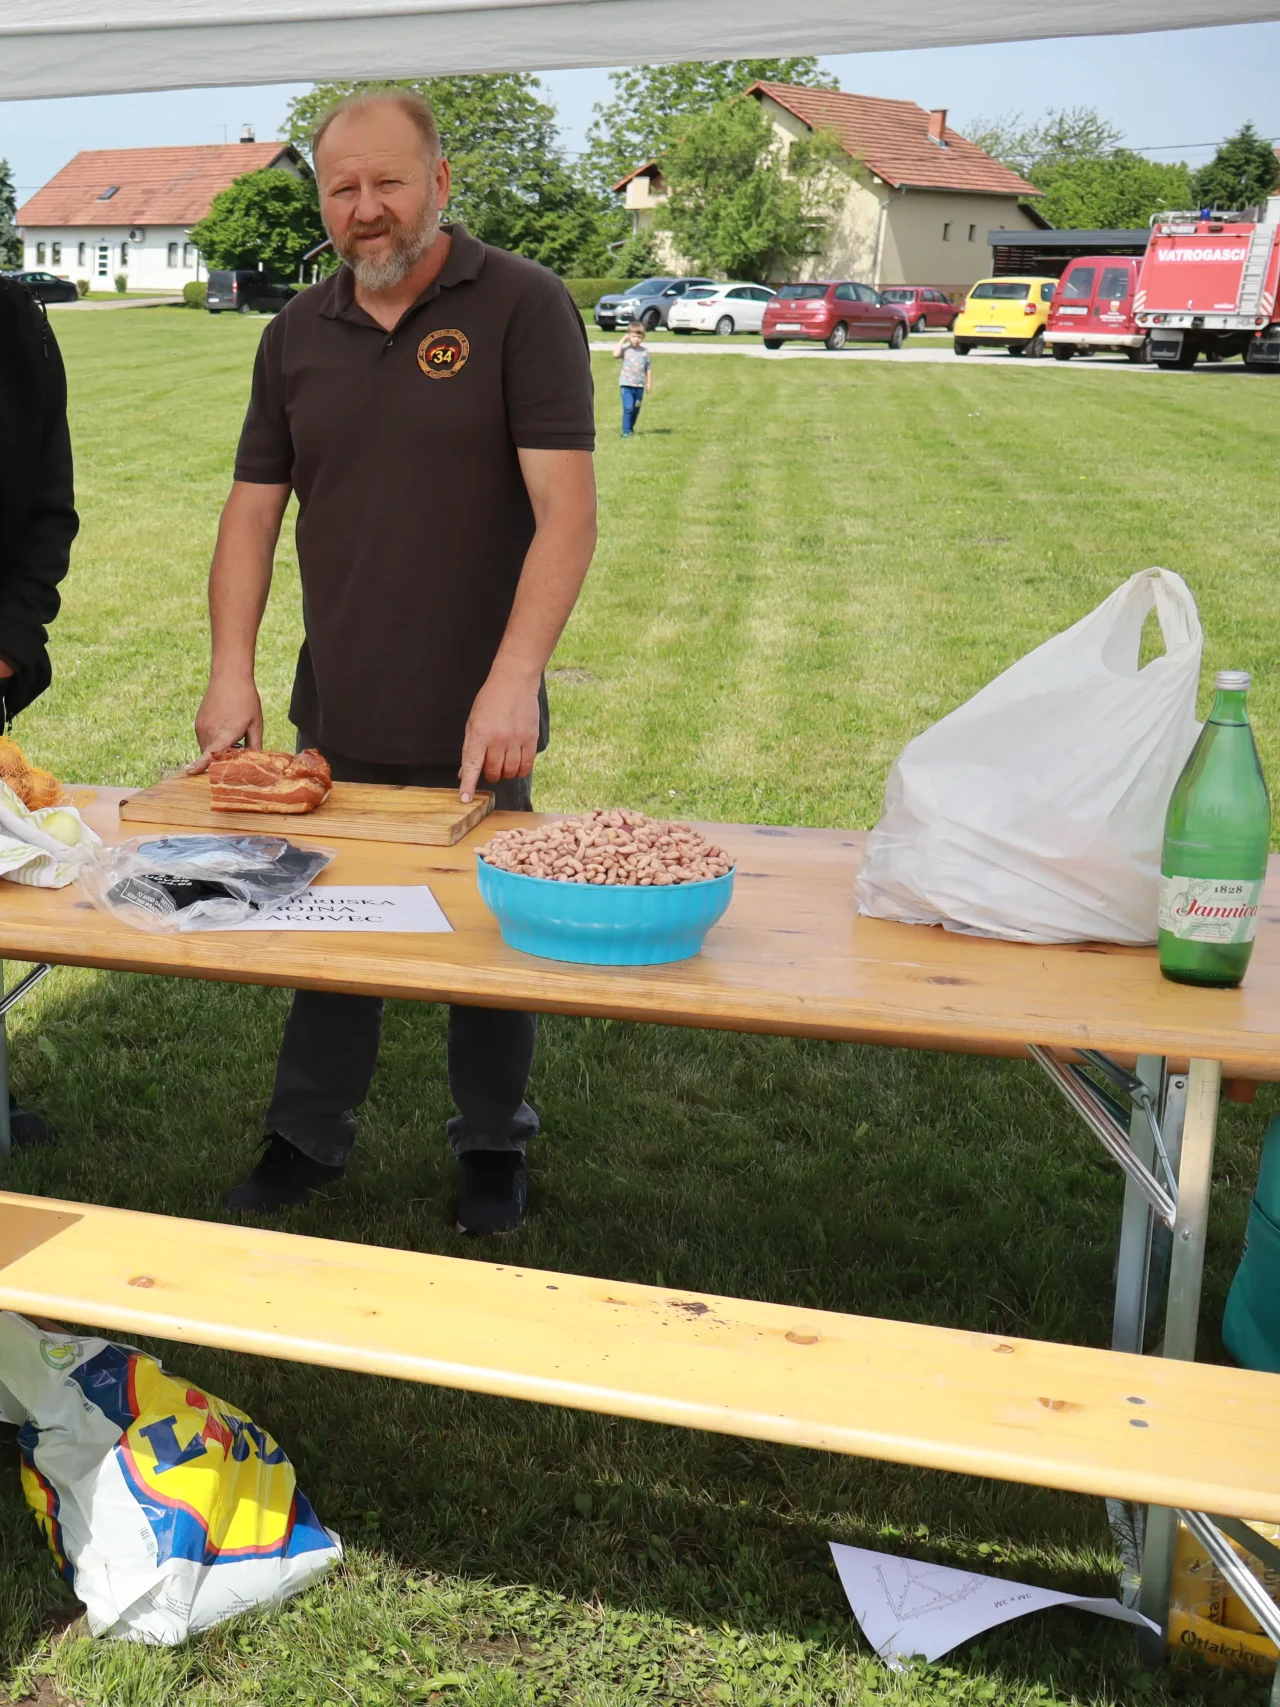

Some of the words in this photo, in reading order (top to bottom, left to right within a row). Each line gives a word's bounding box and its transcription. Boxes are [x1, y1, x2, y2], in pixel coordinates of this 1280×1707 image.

[1158, 249, 1246, 261] VATROGASCI
[434, 350, 452, 363] 34
[1176, 899, 1258, 918] Jamnica
